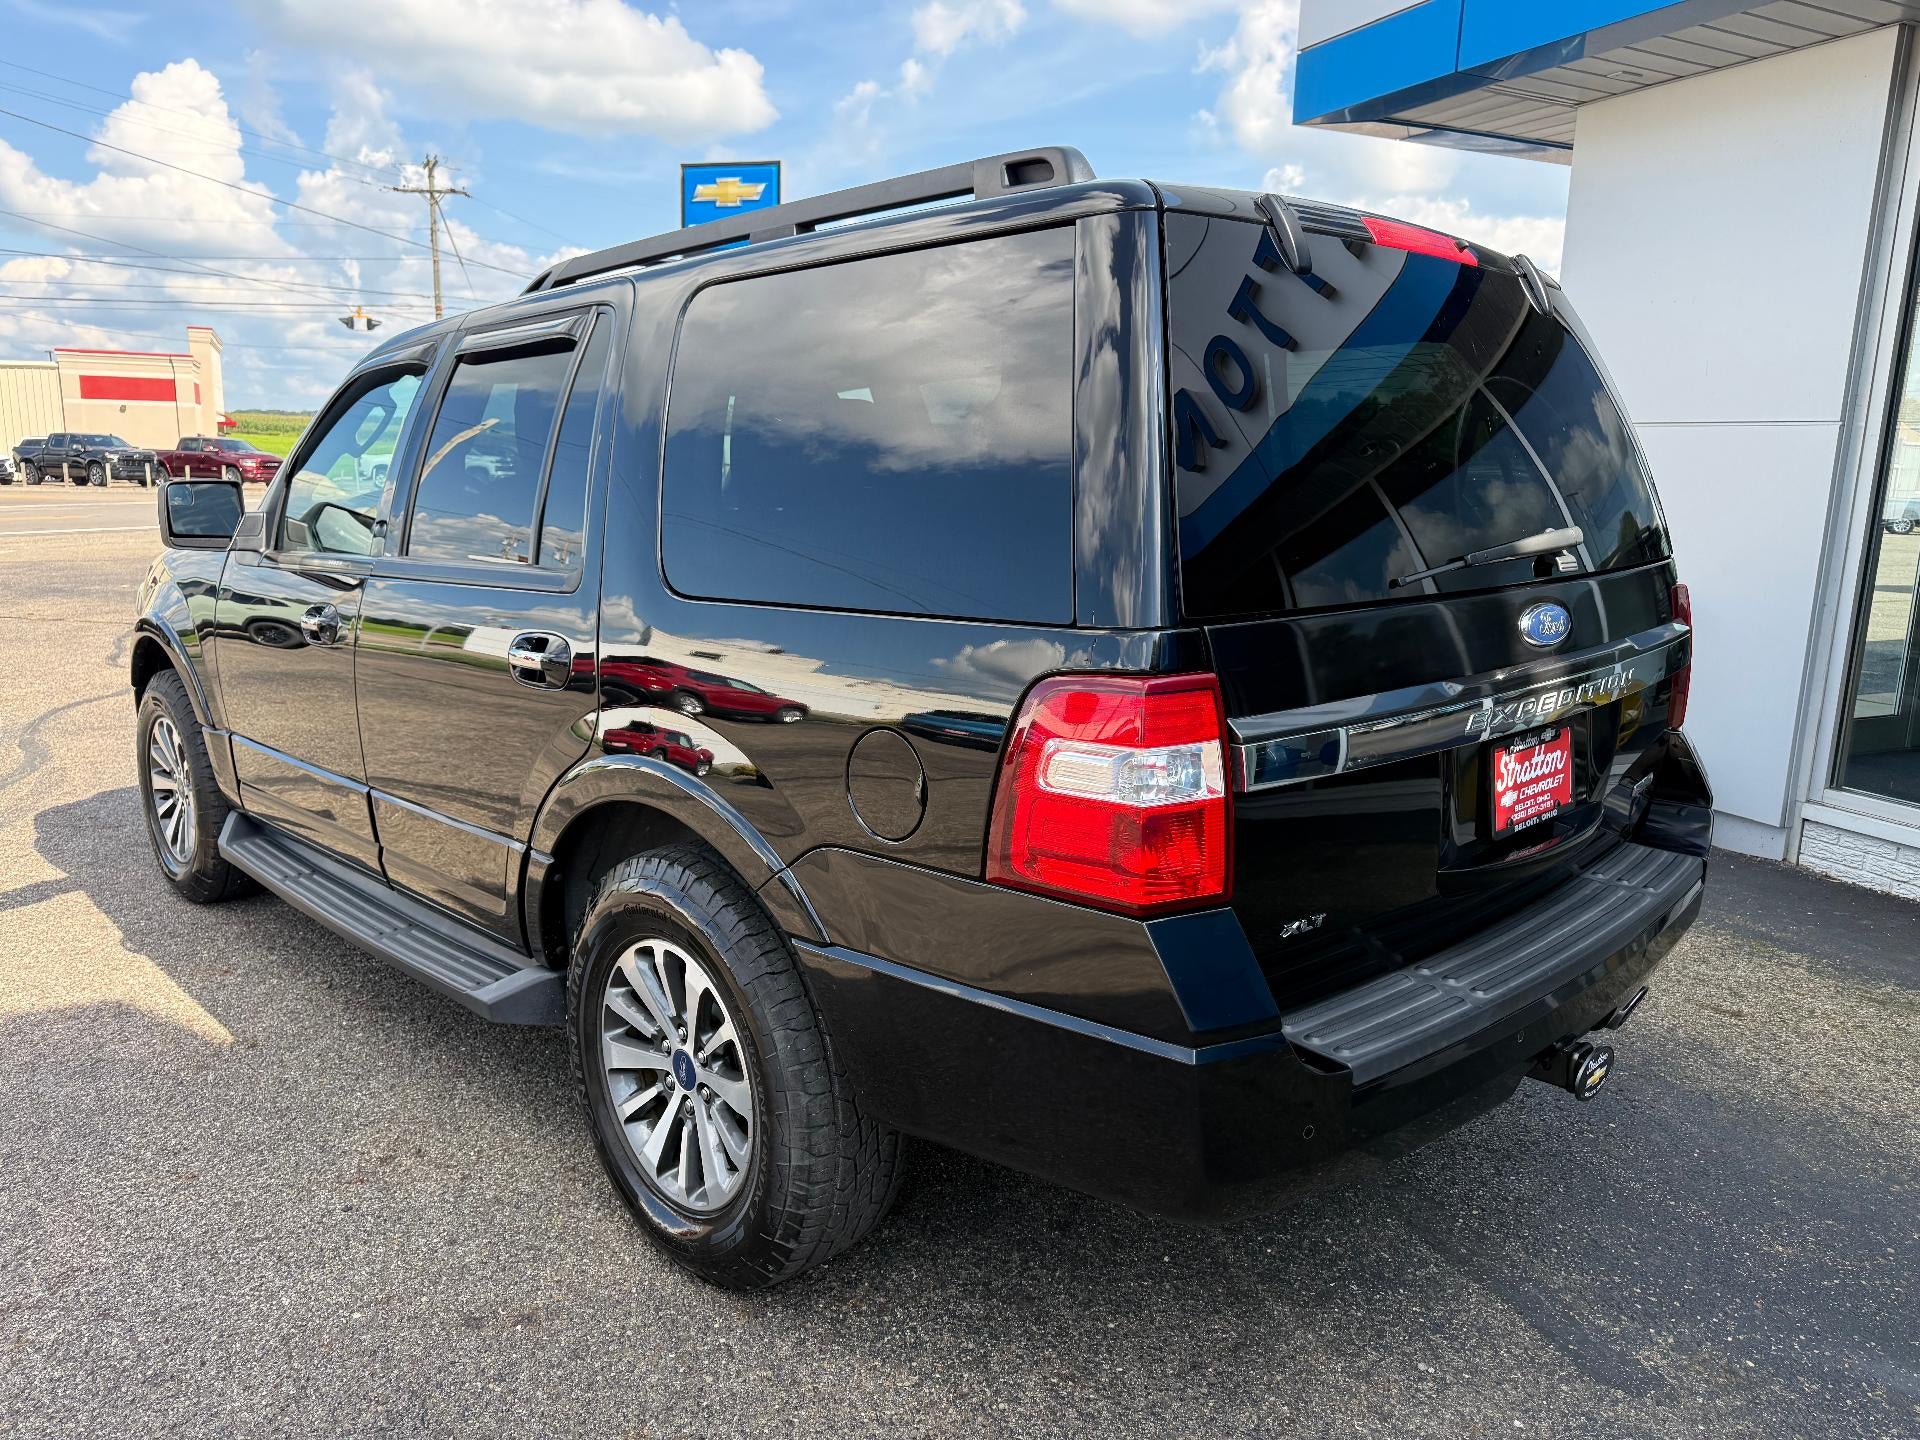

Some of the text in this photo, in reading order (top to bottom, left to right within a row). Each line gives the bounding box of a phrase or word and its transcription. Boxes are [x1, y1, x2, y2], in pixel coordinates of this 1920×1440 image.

[1465, 667, 1635, 736] EXPEDITION
[1497, 744, 1567, 792] Stratton
[1520, 774, 1564, 799] CHEVROLET
[1536, 793, 1551, 804] OHIO
[1541, 809, 1558, 821] OHIO
[1280, 913, 1326, 937] XLT
